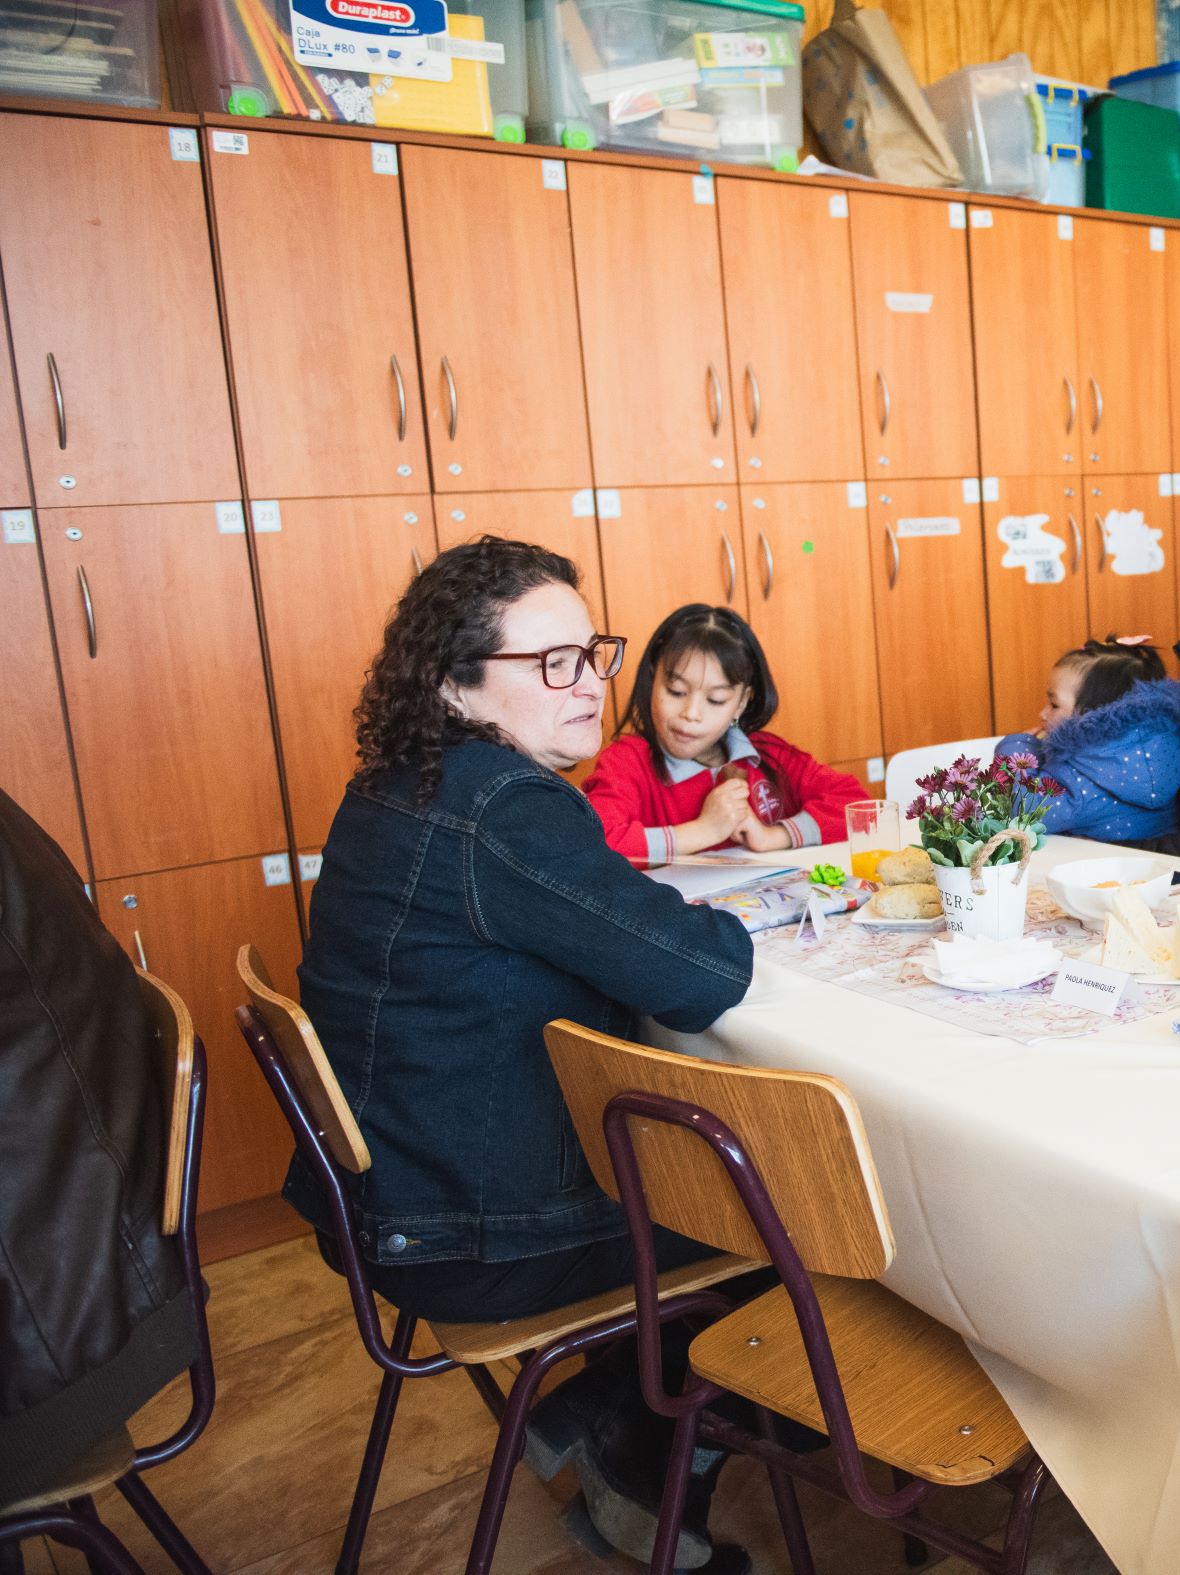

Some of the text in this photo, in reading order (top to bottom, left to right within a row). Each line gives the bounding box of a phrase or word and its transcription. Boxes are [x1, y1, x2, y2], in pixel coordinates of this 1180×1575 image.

[338, 1, 401, 20] Duraplast
[296, 27, 321, 39] Caja
[297, 39, 329, 51] DLux
[334, 43, 356, 55] #80
[176, 142, 192, 153] 18
[223, 511, 238, 522] 20
[10, 520, 25, 531] 19
[940, 890, 974, 912] ERS
[1065, 974, 1116, 993] PAOLA HENRIQUEZ
